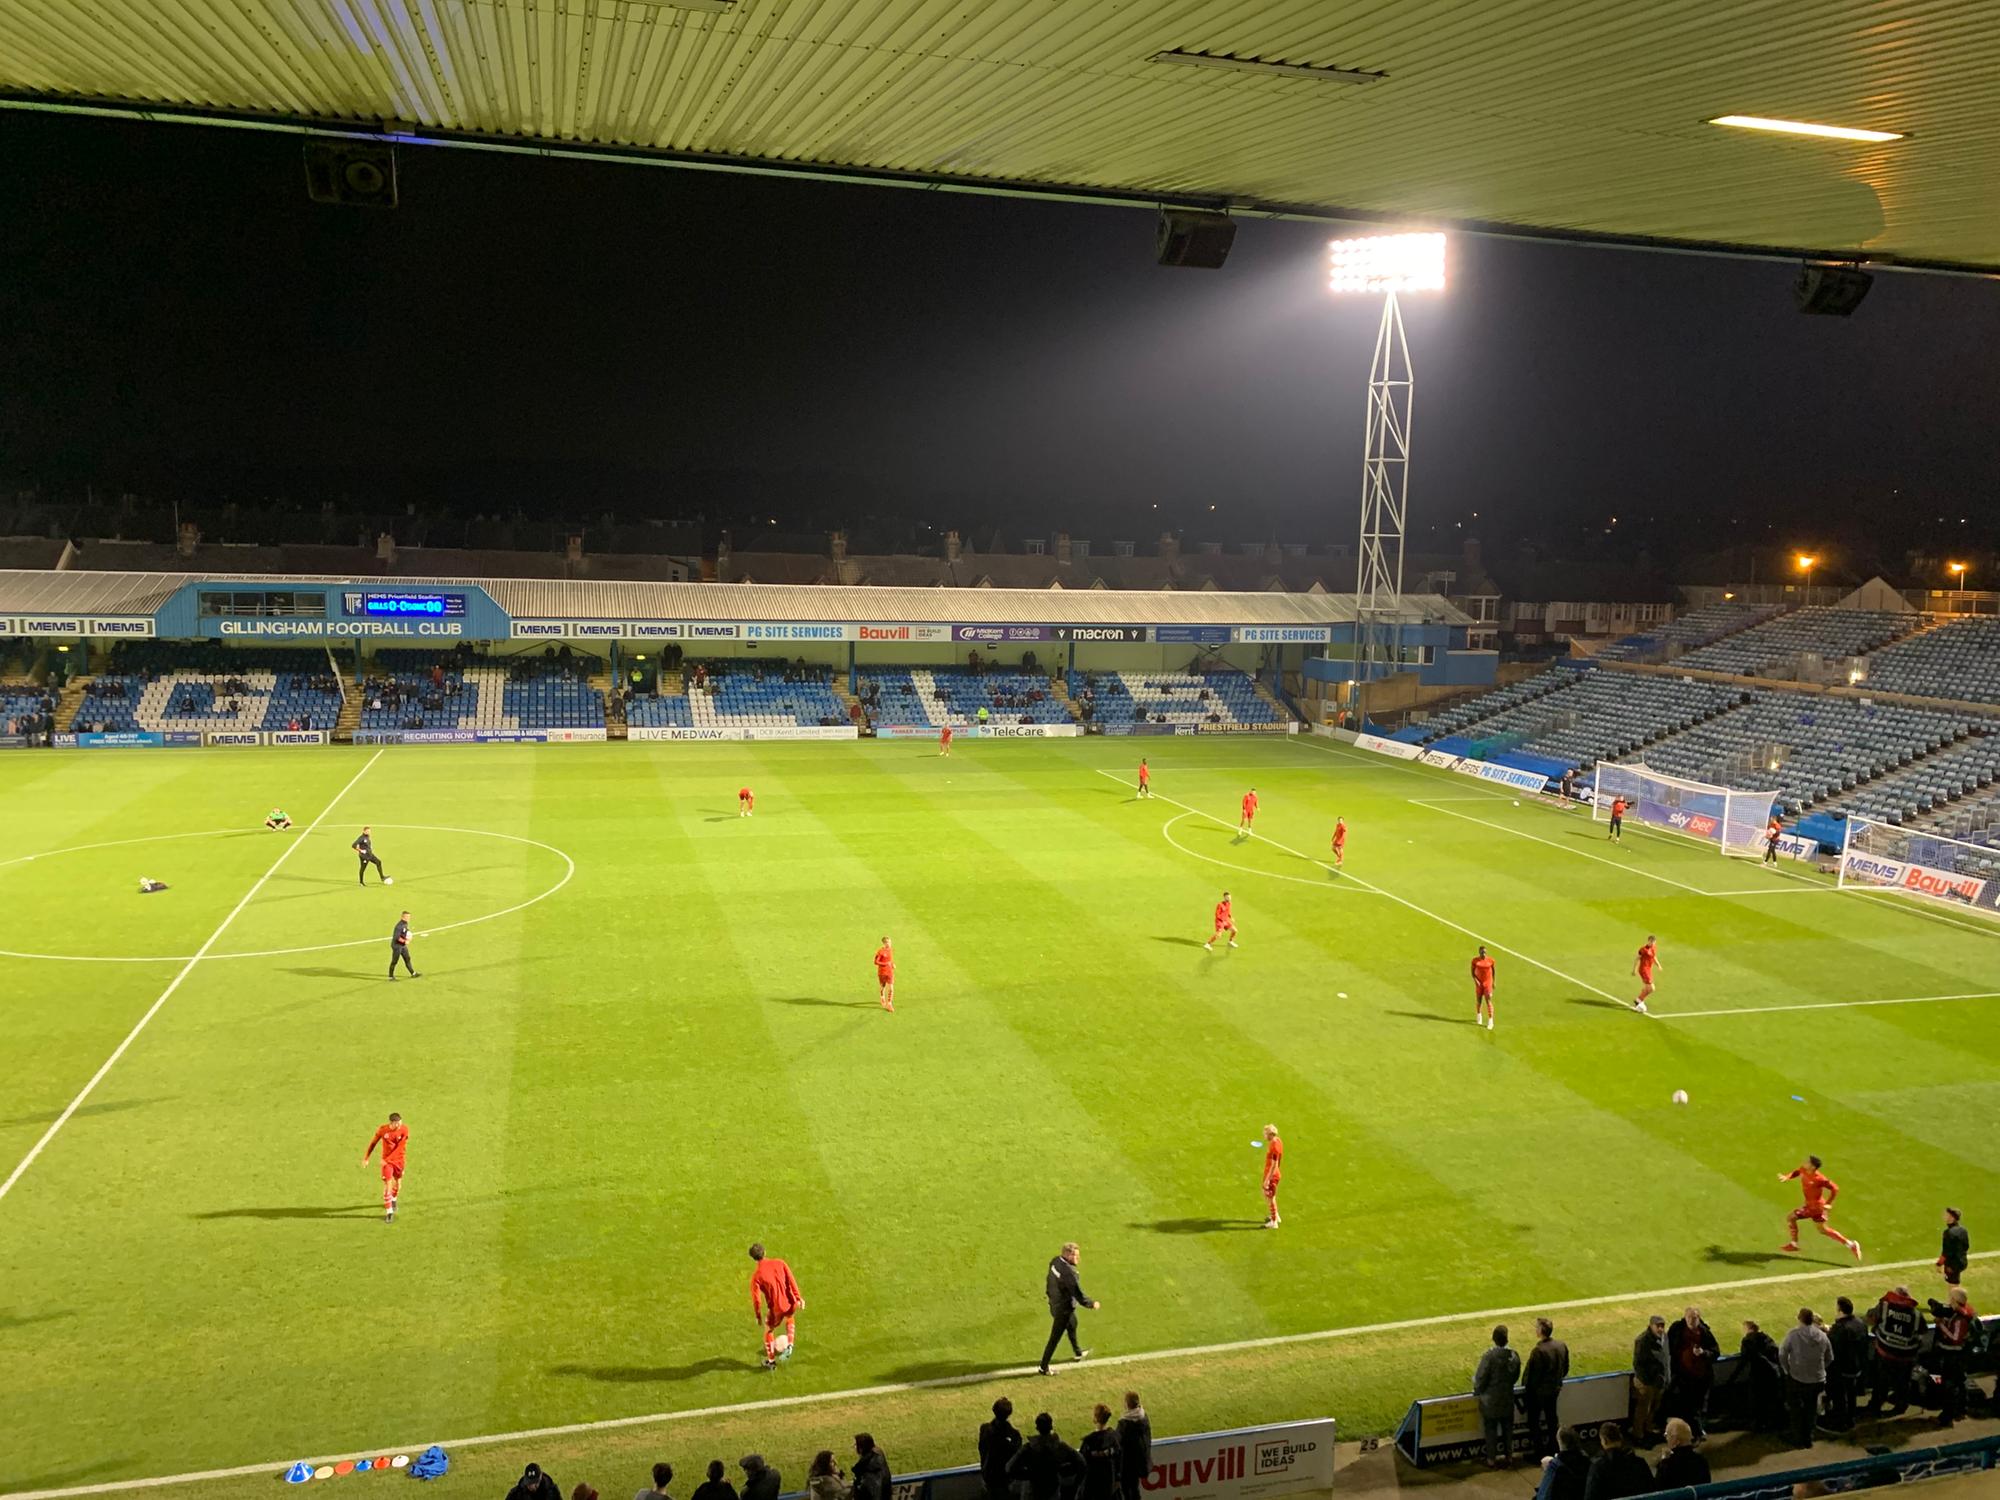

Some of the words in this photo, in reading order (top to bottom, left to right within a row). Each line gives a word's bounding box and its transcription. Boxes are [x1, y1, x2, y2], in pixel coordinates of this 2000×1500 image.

[28, 622, 76, 631] MEMS
[97, 622, 145, 632] MEMS
[220, 621, 323, 635] GILLINGHAM
[326, 622, 414, 635] FOOTBALL
[418, 622, 462, 635] CLUB
[520, 625, 561, 634] MEMS
[579, 625, 620, 635] MEMS
[637, 626, 678, 635] MEMS
[695, 627, 734, 636] MEMS
[748, 626, 762, 638] PG
[765, 626, 790, 638] SITE
[792, 627, 843, 638] SERVICES
[859, 626, 910, 639] Bauvill
[1073, 628, 1124, 640] macron
[1245, 629, 1257, 640] PG
[1259, 629, 1280, 640] SITE
[1281, 629, 1326, 640] SERVICES
[992, 726, 1044, 737] TeleCare
[1174, 724, 1196, 736] Kent
[1198, 723, 1250, 731] PRIESTFIELD
[1252, 723, 1288, 731] STADIUM
[54, 734, 76, 742] LIVE
[211, 735, 256, 744] MEMS
[276, 734, 319, 743] MEMS
[573, 732, 606, 741] Insurance
[639, 730, 667, 740] LIVE
[671, 729, 723, 740] MEDWAY
[1480, 766, 1490, 776] PG
[1490, 768, 1508, 781] SITE
[1507, 772, 1544, 790] SERVICES
[1668, 812, 1690, 829] sky
[1691, 816, 1713, 834] bet
[1847, 857, 1898, 878] MEMS
[1888, 1309, 1912, 1322] PHOTO
[1893, 1324, 1903, 1334] 14
[1261, 1448, 1280, 1458] WE
[1283, 1441, 1316, 1455] BUILD
[1361, 1438, 1379, 1450] 25
[1261, 1454, 1295, 1468] IDEAS
[1141, 1446, 1246, 1491] auvill
